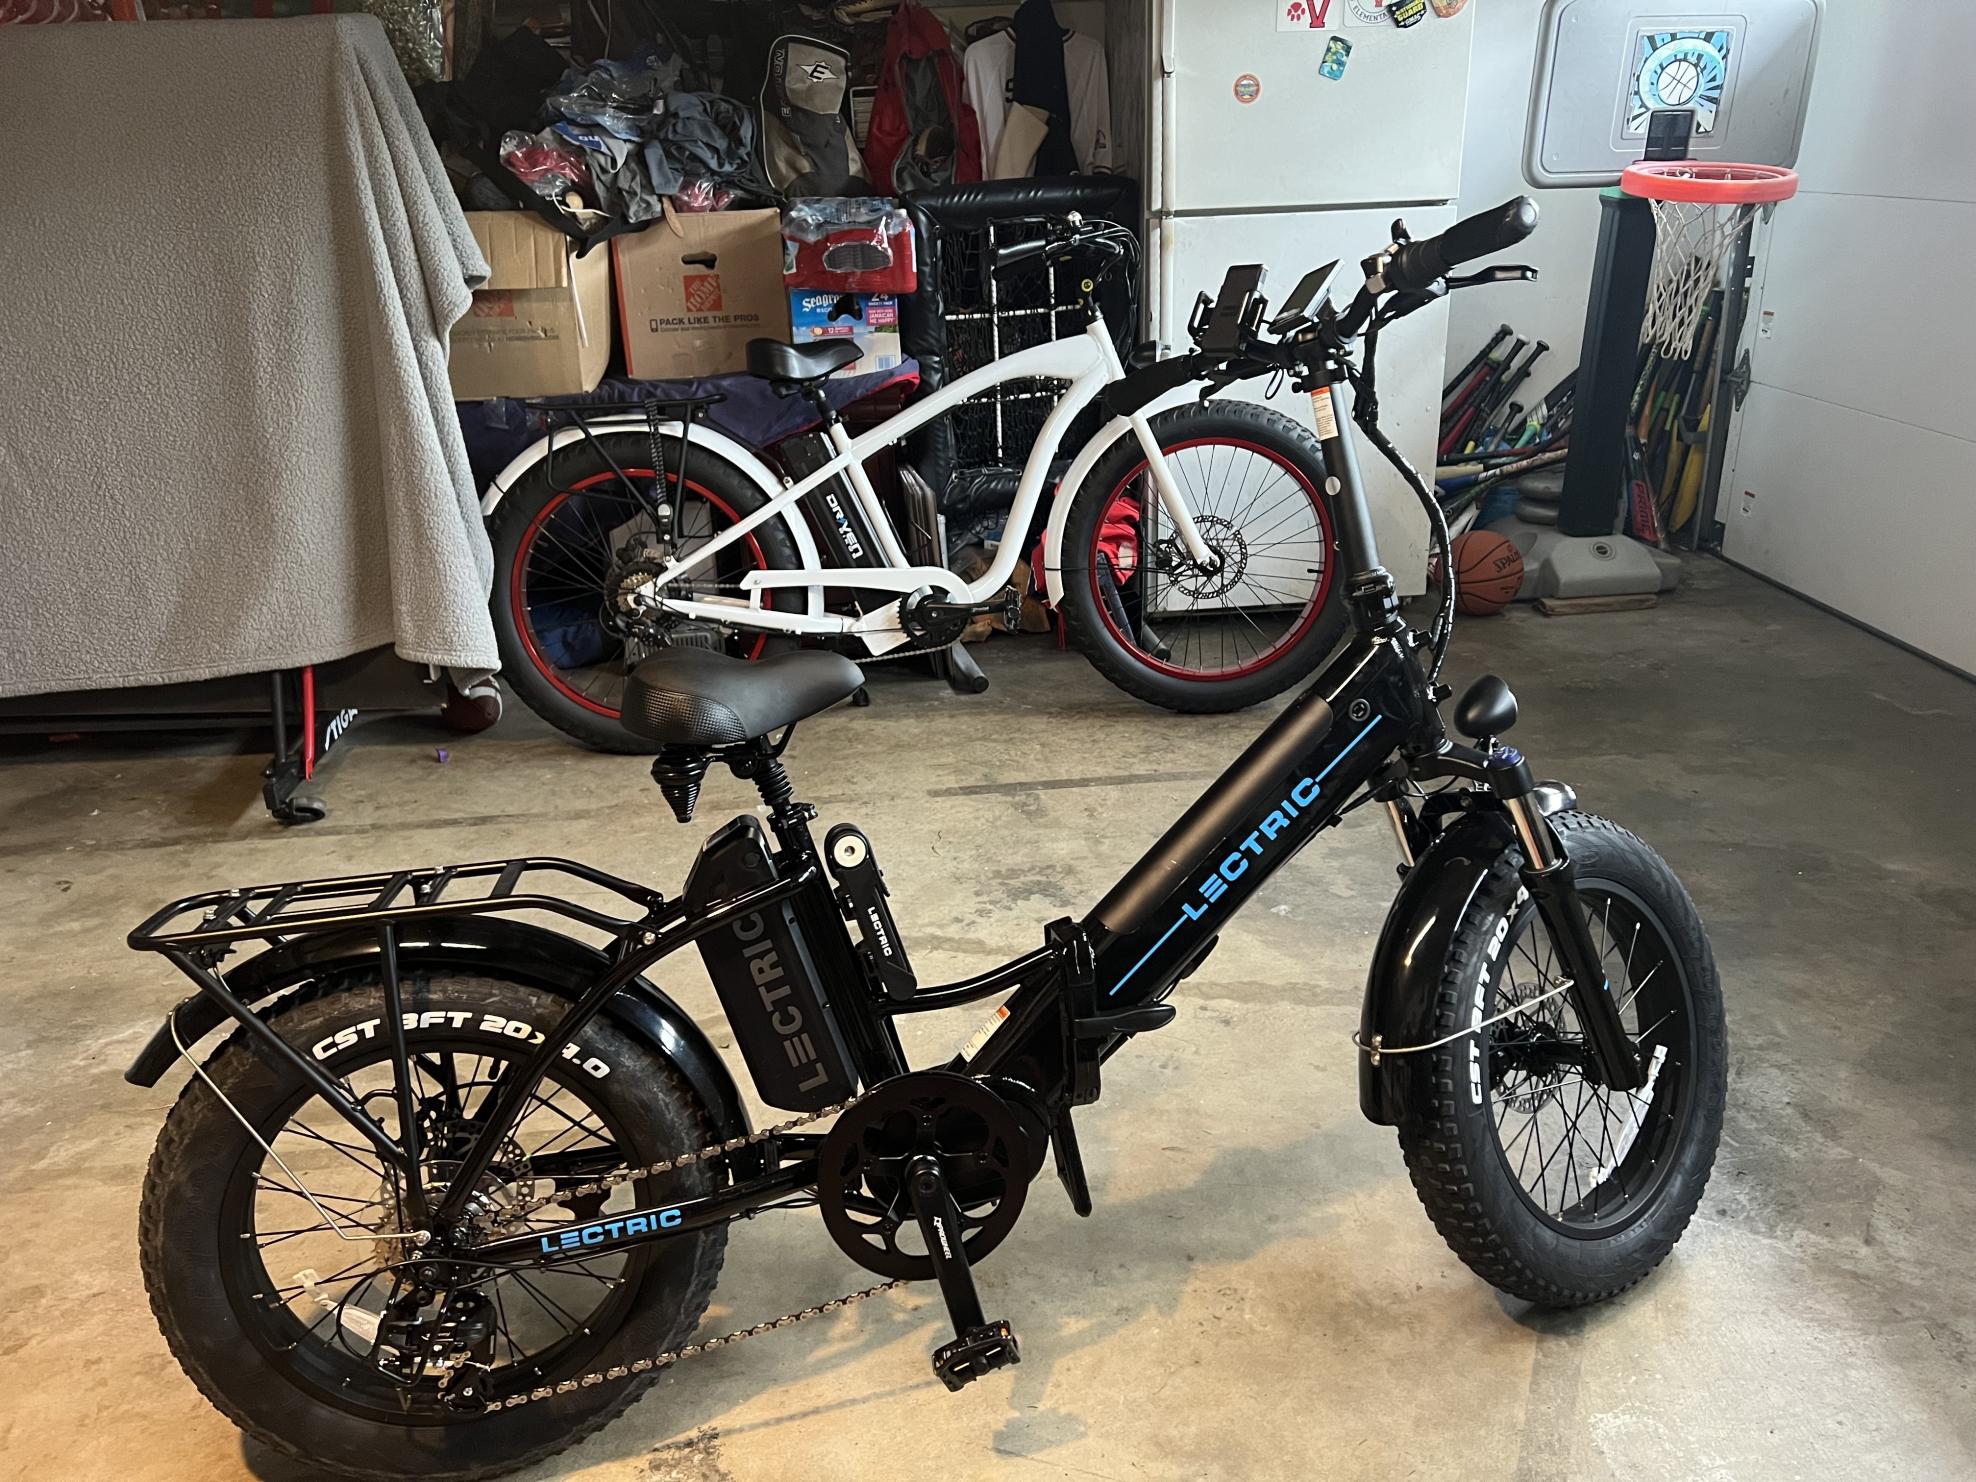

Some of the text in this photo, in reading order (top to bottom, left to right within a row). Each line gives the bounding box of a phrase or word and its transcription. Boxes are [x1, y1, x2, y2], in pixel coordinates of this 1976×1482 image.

[1353, 5, 1390, 21] ELEMENTA
[1397, 2, 1424, 21] GUARD
[808, 63, 830, 81] E
[660, 313, 760, 326] PACK LIKE THE PROS
[1182, 777, 1320, 921] LECTRIC
[867, 906, 893, 957] LECTRIC
[732, 911, 830, 1093] LECTRIC
[311, 1018, 381, 1061] CST
[1469, 1039, 1483, 1105] CST
[541, 1208, 682, 1253] LECTRIC
